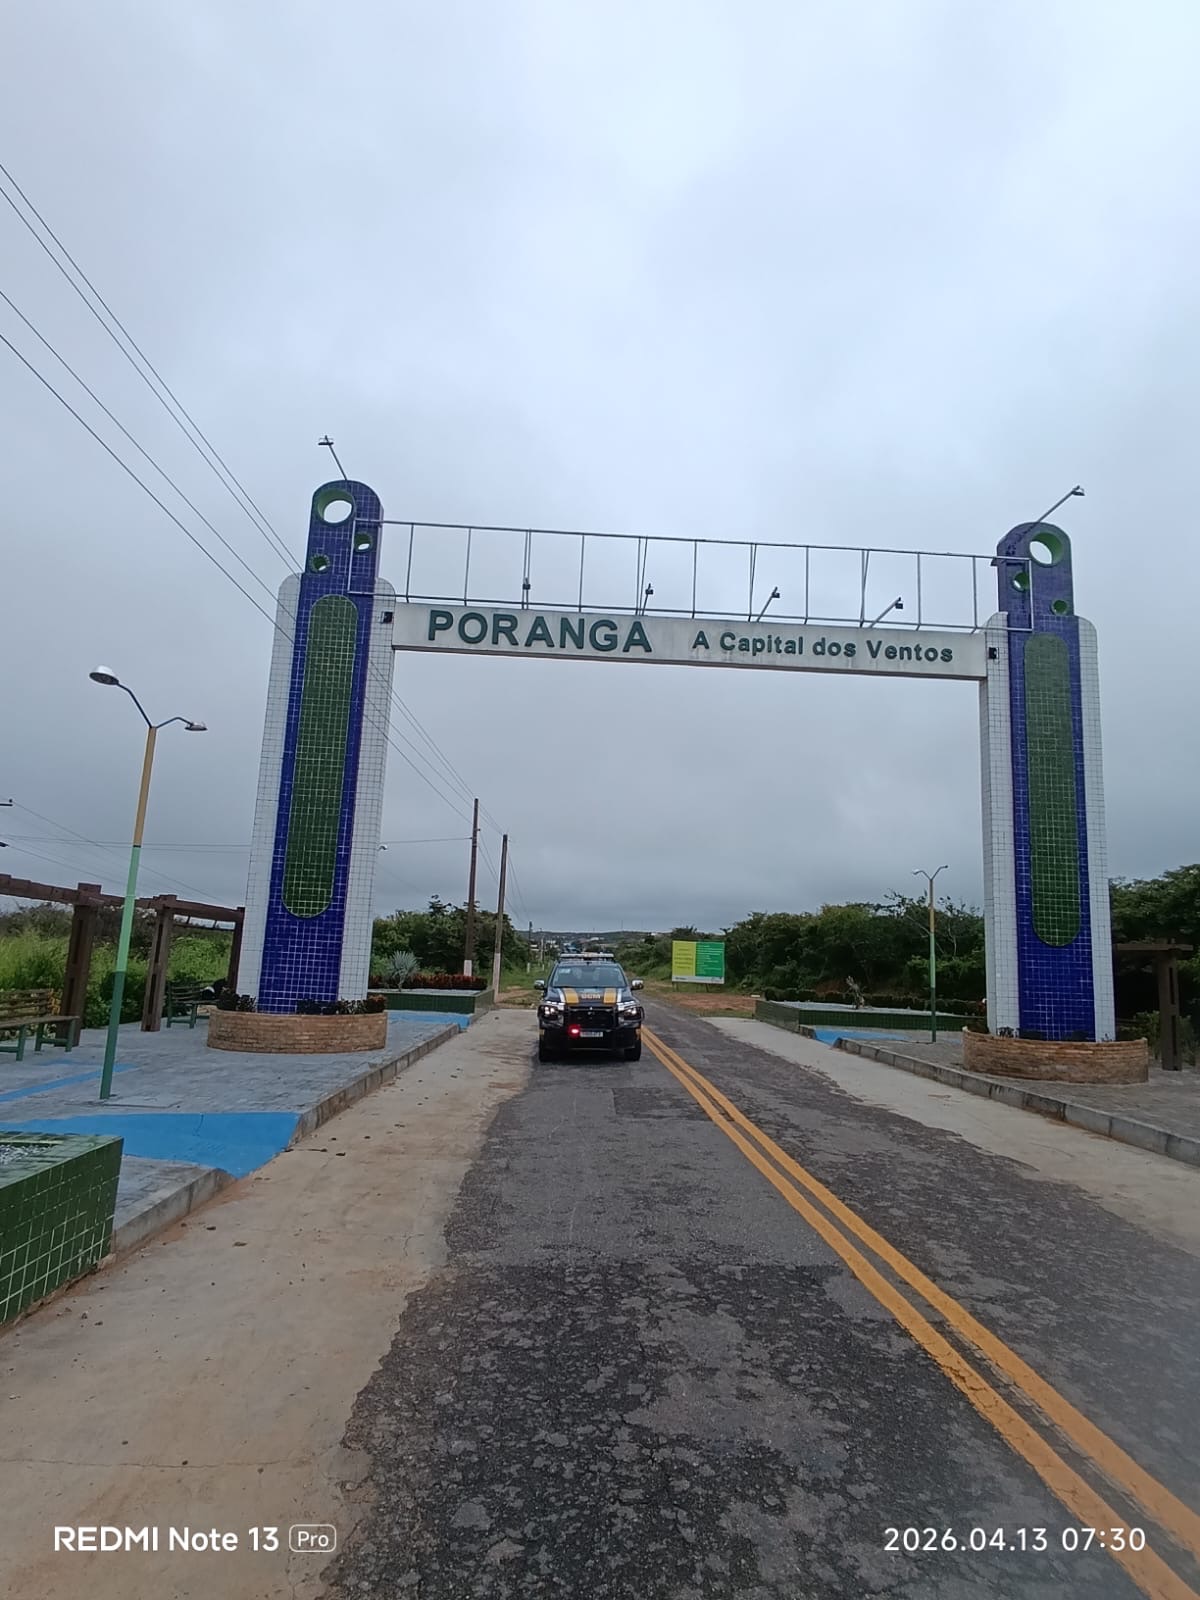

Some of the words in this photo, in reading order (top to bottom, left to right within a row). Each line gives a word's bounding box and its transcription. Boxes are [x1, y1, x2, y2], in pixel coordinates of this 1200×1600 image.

[428, 610, 652, 652] PORANGA
[692, 630, 710, 650] A
[719, 632, 803, 656] Capital
[812, 637, 857, 658] dos
[866, 640, 953, 662] Ventos
